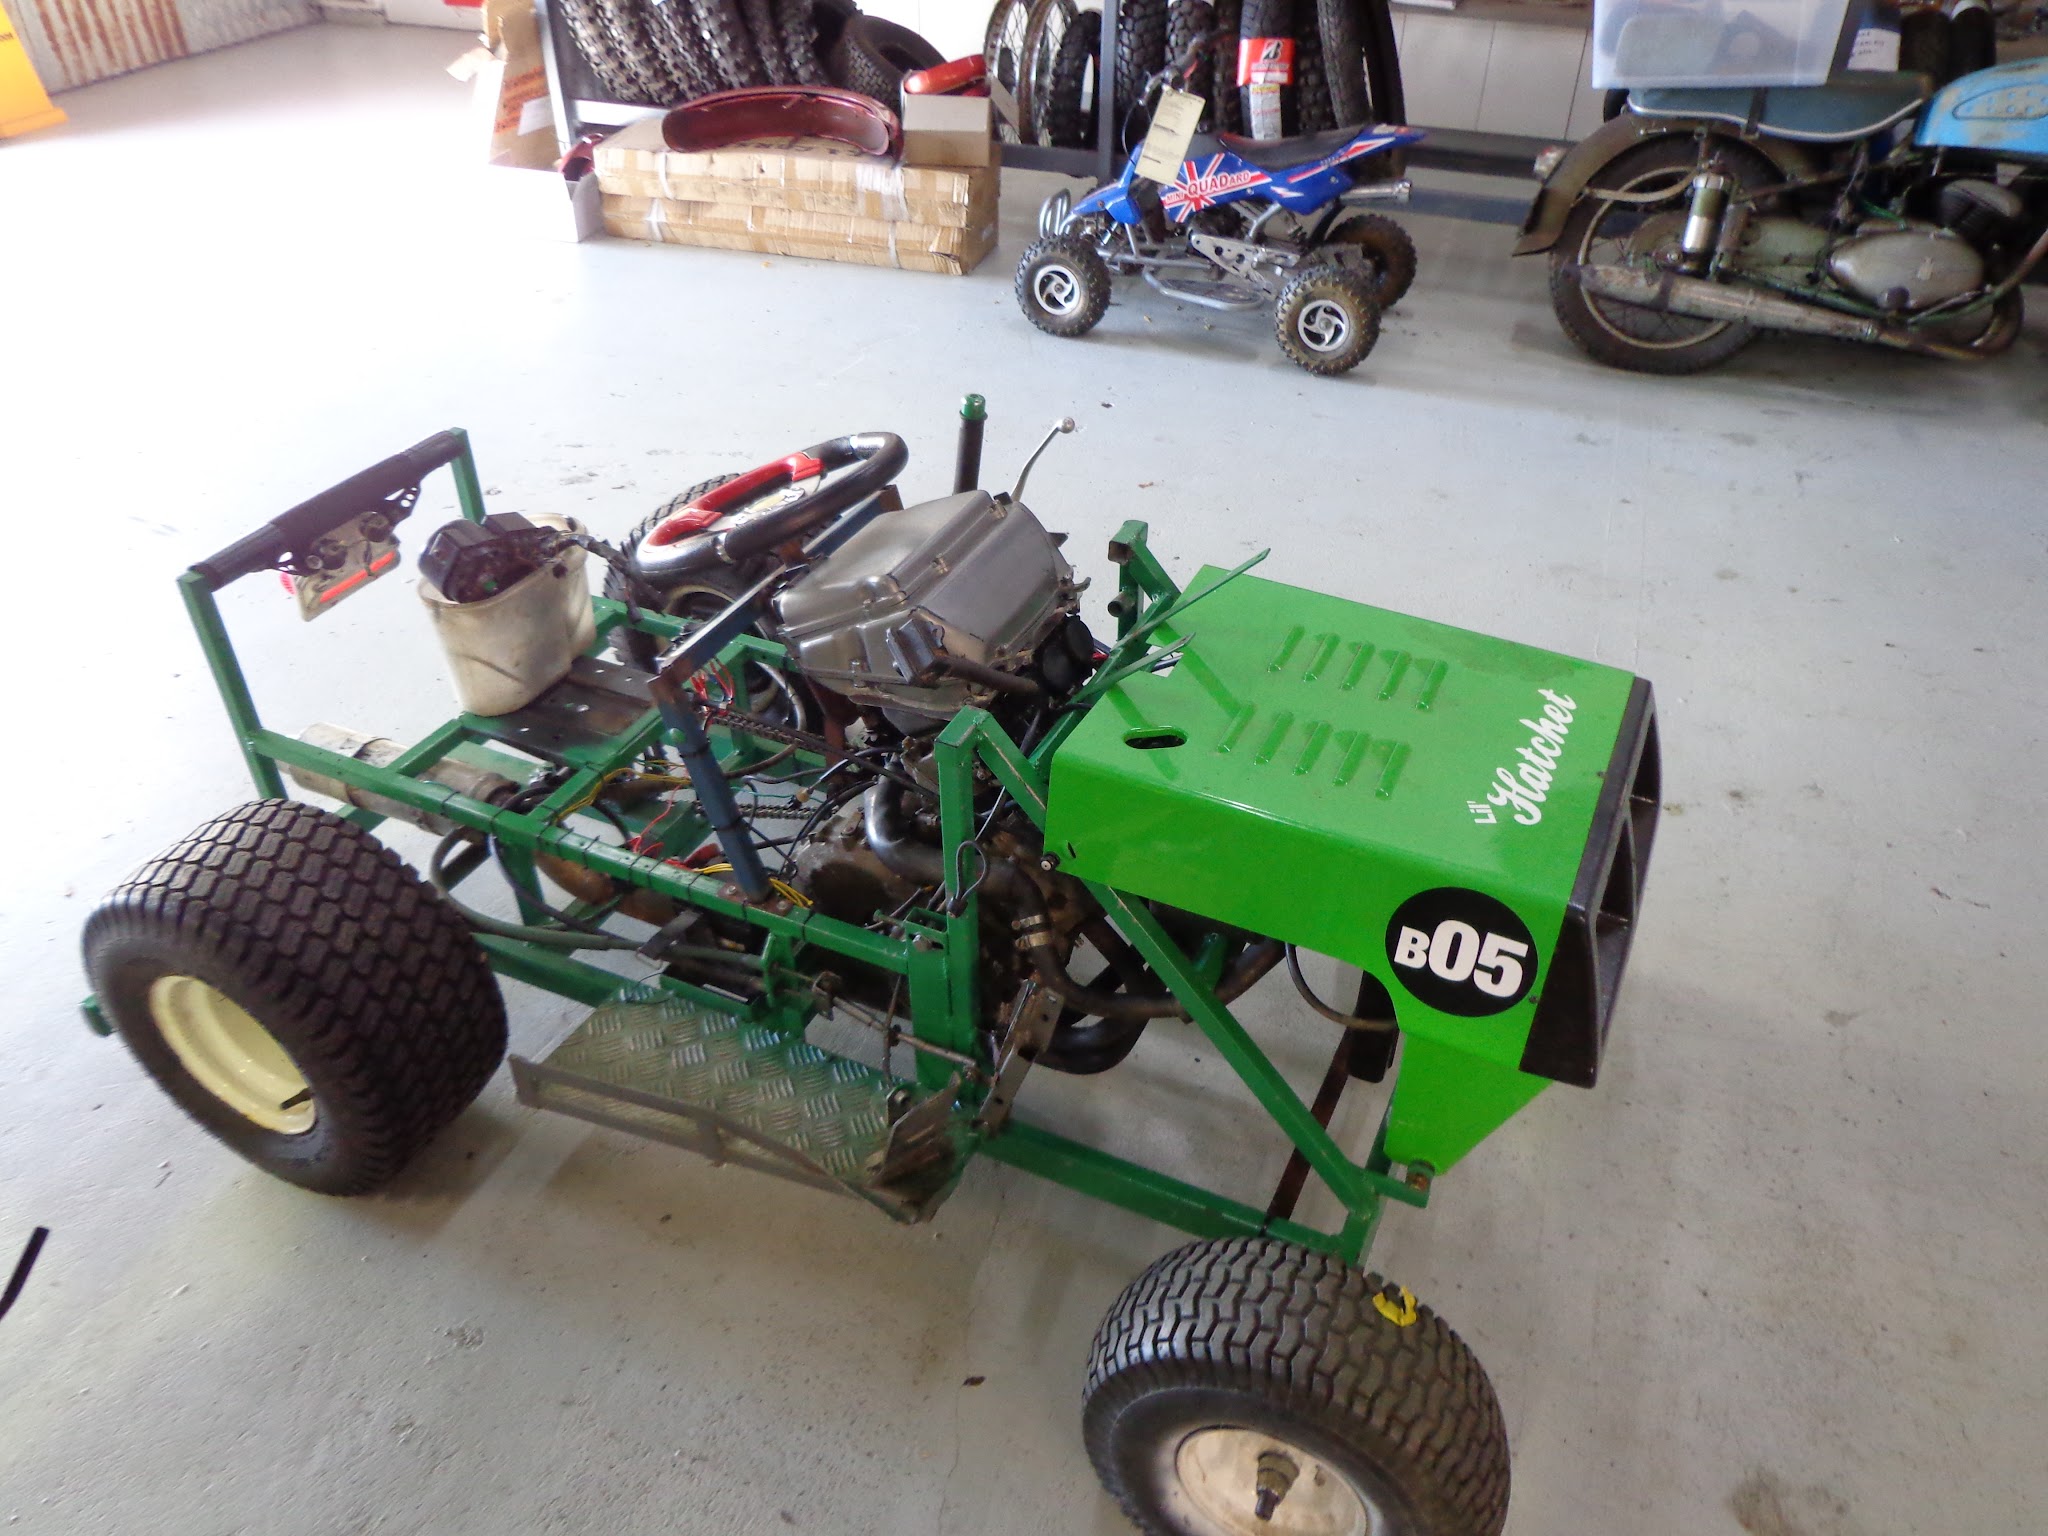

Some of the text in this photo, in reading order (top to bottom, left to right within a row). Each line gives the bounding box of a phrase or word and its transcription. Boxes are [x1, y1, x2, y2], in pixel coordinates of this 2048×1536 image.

[1166, 191, 1185, 202] MINI
[1486, 688, 1577, 826] Hatchet
[1393, 919, 1529, 998] B05
